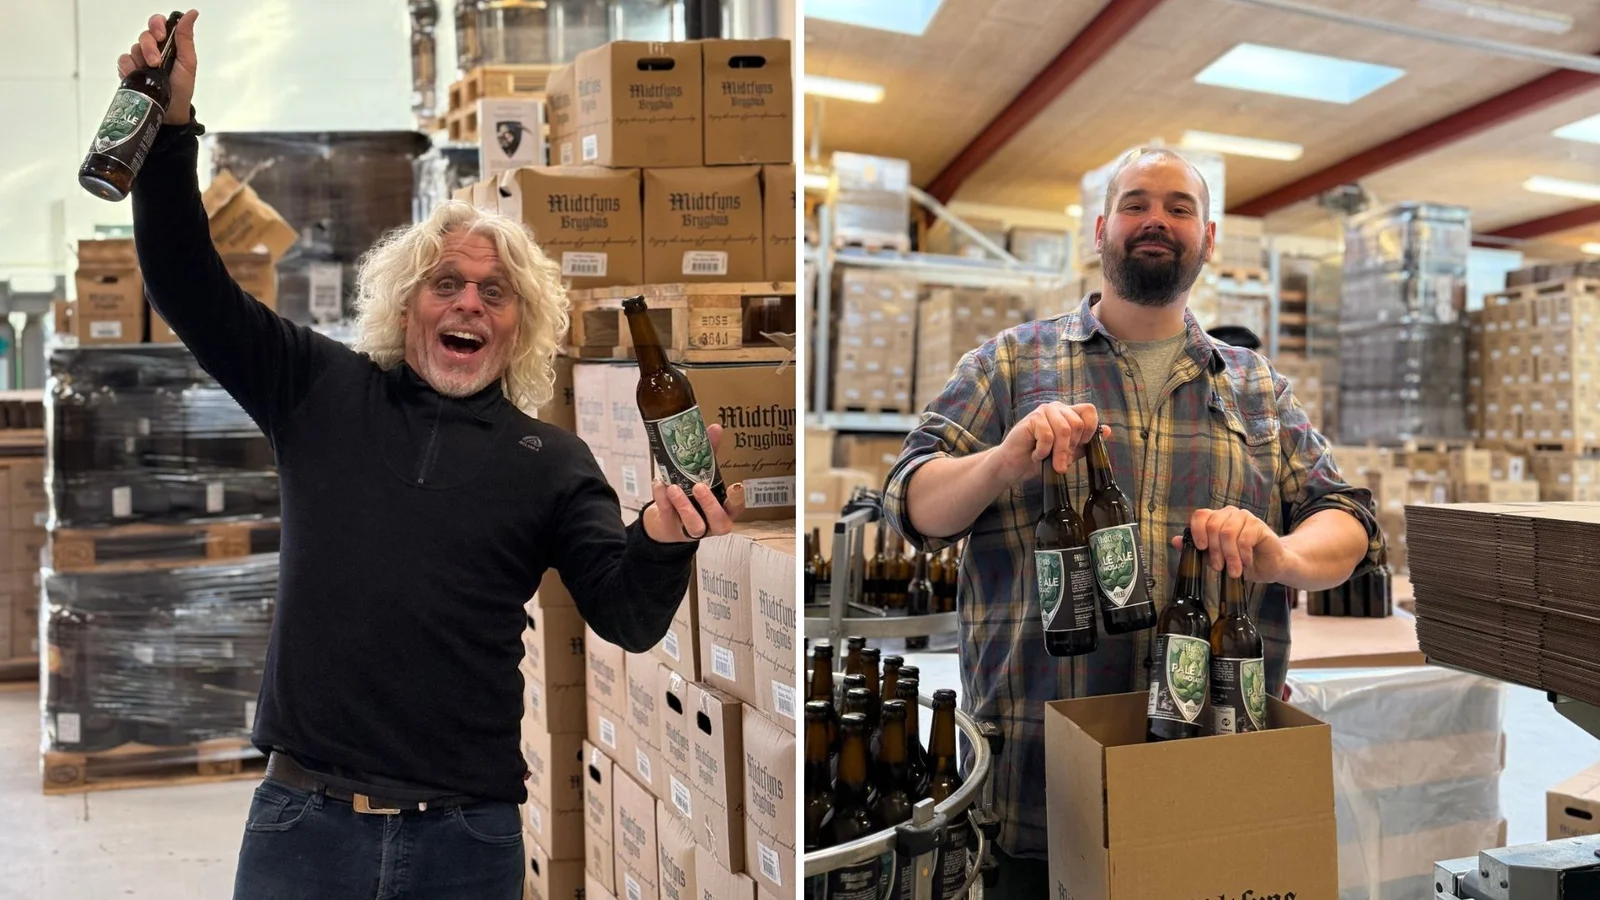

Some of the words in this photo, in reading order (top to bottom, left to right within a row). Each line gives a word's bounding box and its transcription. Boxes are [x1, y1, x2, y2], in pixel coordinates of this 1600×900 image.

[629, 82, 682, 98] Midtfyns
[721, 80, 773, 95] Midtfyns
[120, 113, 139, 125] ALE
[548, 193, 621, 215] Midtfyns
[668, 191, 741, 214] Midtfyns
[560, 215, 609, 232] Bryghus
[682, 213, 728, 230] Bryghus
[718, 404, 796, 431] Midtfyn
[734, 431, 794, 451] Bryghus
[1117, 551, 1134, 563] ALE
[701, 568, 739, 604] Midtfyns
[1044, 577, 1059, 587] ALE
[1171, 662, 1196, 676] PALE
